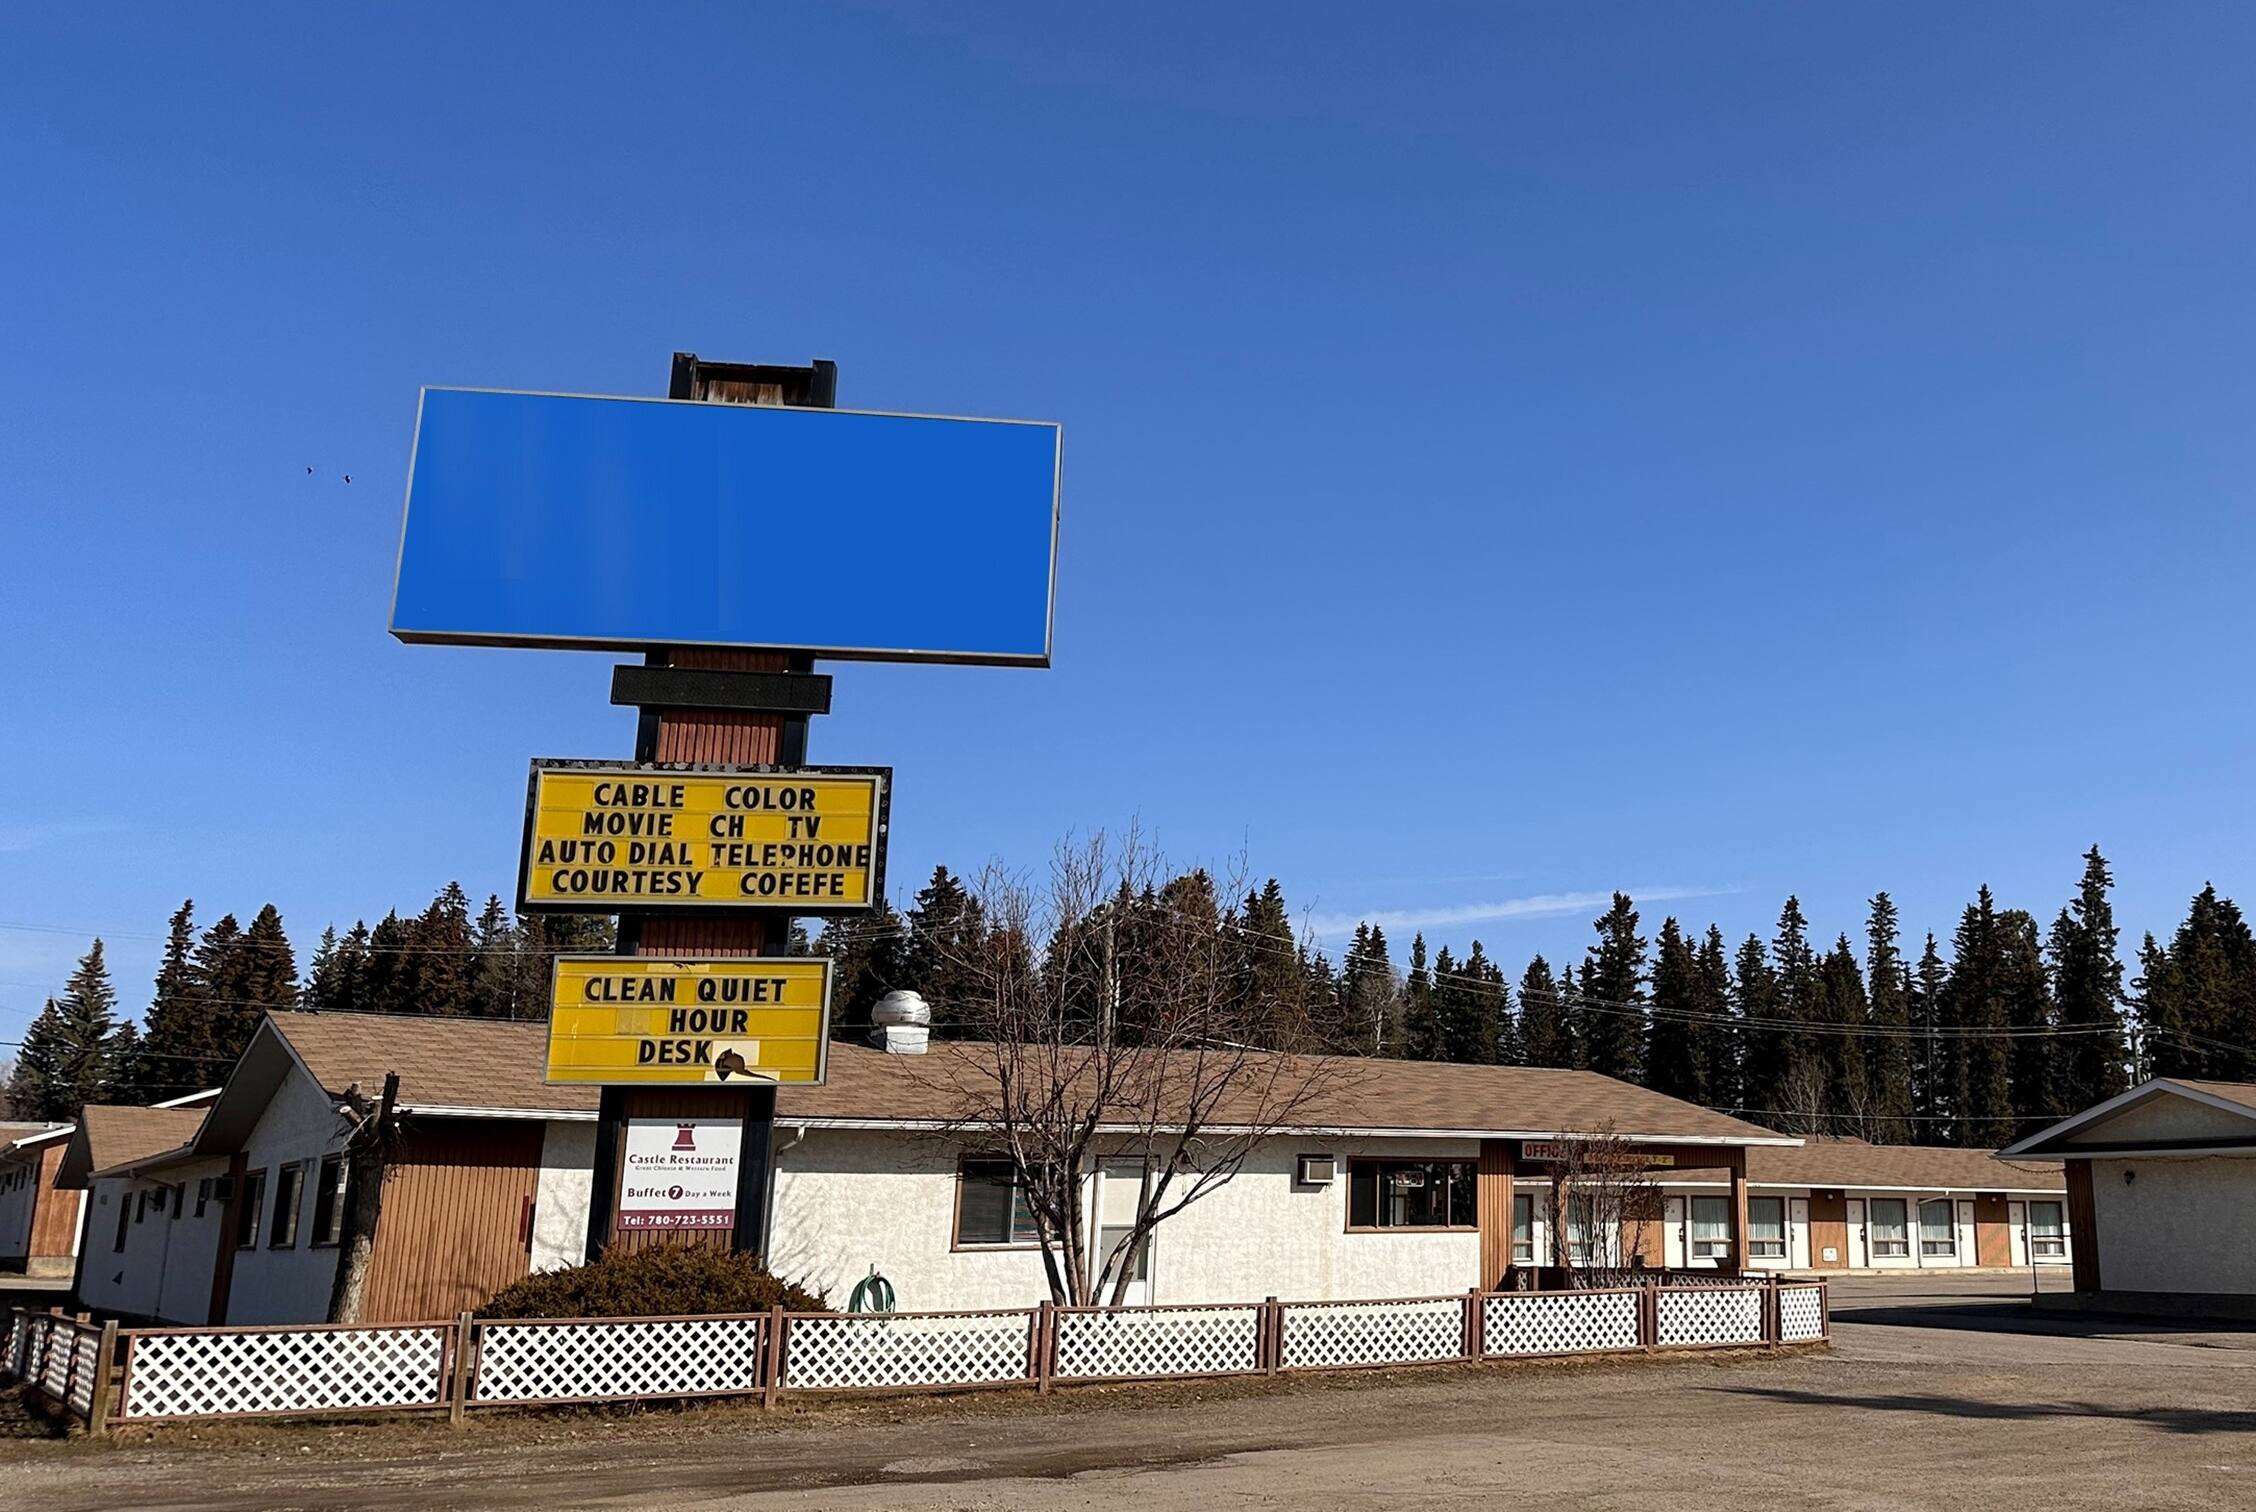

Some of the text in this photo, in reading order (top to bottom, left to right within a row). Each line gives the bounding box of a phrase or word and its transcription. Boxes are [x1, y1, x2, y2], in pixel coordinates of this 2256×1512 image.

[594, 783, 816, 810] CABLE COLOR
[583, 812, 821, 839] MOVIE CH TV
[539, 840, 870, 868] AUTO DIAL TELEPHONE
[552, 869, 844, 896] COURTESY COFEFE
[584, 977, 786, 1002] CLEAN QUIET
[669, 1009, 748, 1032] HOUR
[639, 1040, 712, 1064] DESK
[629, 1154, 734, 1164] Castle Restaurant
[628, 1188, 666, 1197] Buffet
[672, 1188, 680, 1198] 7
[624, 1216, 729, 1224] Tel: 780-723-5551
